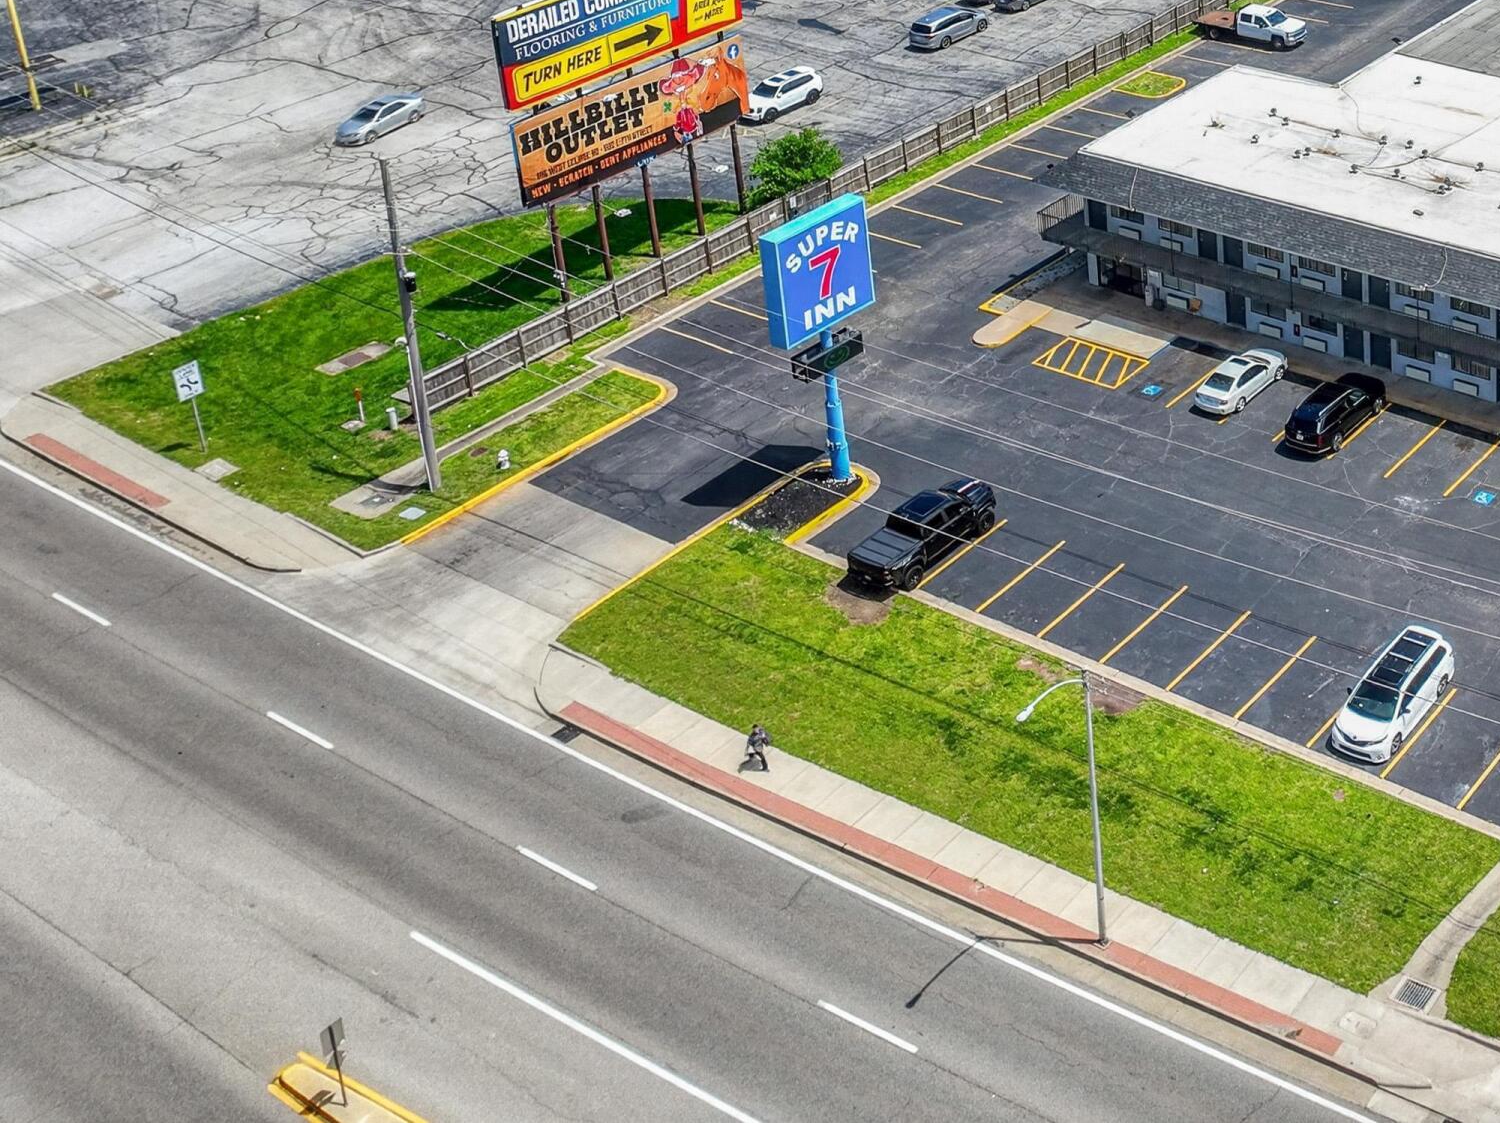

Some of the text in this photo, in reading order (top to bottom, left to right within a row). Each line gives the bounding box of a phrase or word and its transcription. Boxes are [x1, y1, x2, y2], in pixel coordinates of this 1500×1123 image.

[693, 0, 710, 13] AREA
[704, 5, 724, 21] MORE
[515, 23, 586, 61] FLOORING
[588, 21, 598, 33] &
[523, 45, 602, 92] TURN HERE
[519, 81, 660, 157] HILLBILLY
[545, 107, 645, 163] OUTLET
[531, 183, 552, 199] NEW
[558, 164, 594, 188] SCRATCH
[600, 152, 620, 169] DENT
[622, 133, 668, 159] APPLIANCES
[785, 220, 860, 274] SUPER
[808, 244, 841, 300] 7
[803, 285, 857, 331] INN
